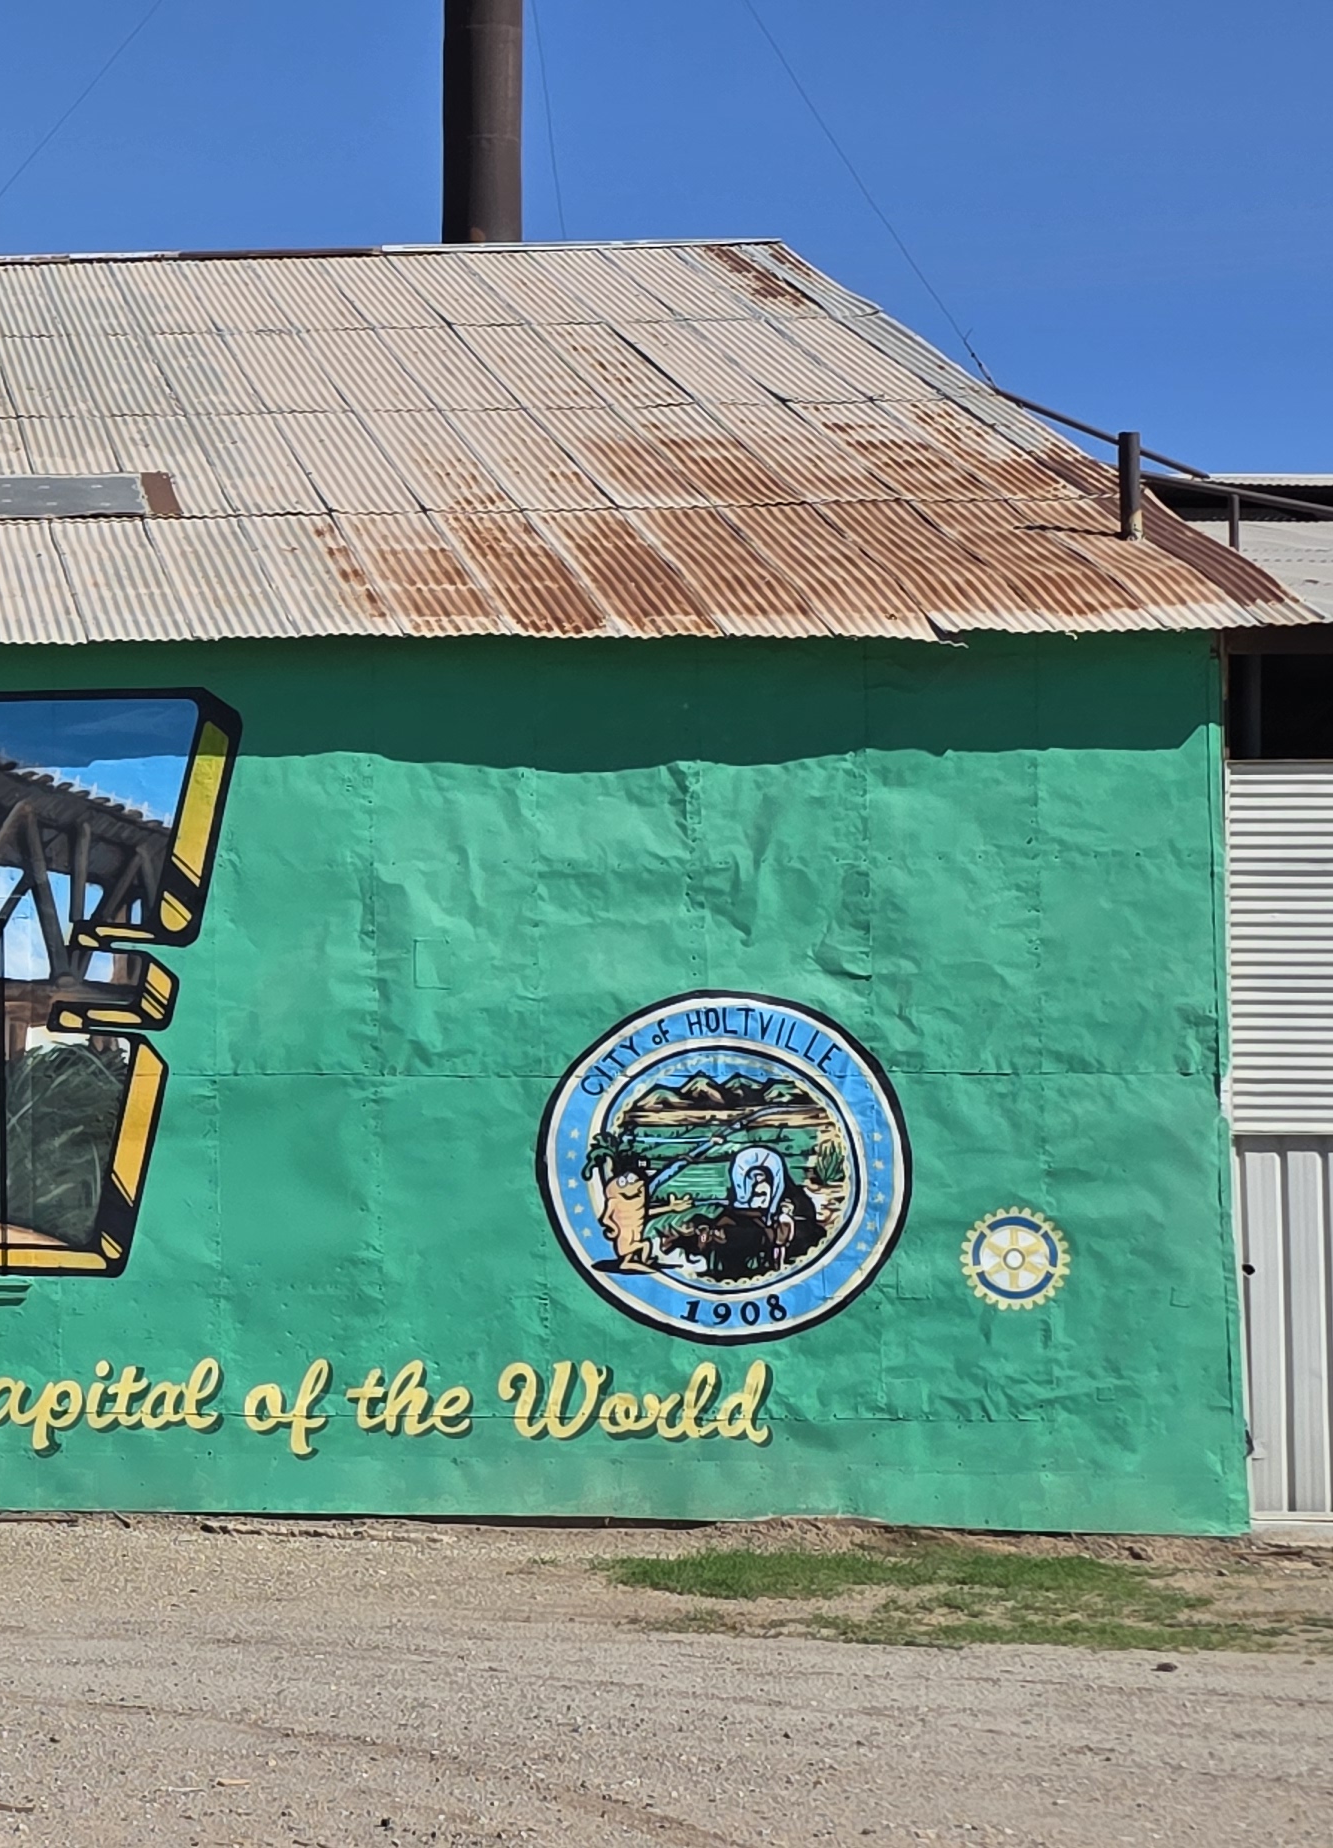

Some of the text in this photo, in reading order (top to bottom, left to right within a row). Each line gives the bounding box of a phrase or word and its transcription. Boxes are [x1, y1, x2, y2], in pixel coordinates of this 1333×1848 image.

[579, 1035, 642, 1097] CITY
[686, 1007, 846, 1075] HOLTVILLE
[679, 1293, 788, 1326] 1908
[244, 1357, 333, 1458] of
[346, 1359, 474, 1438] the
[498, 1359, 773, 1446] World
